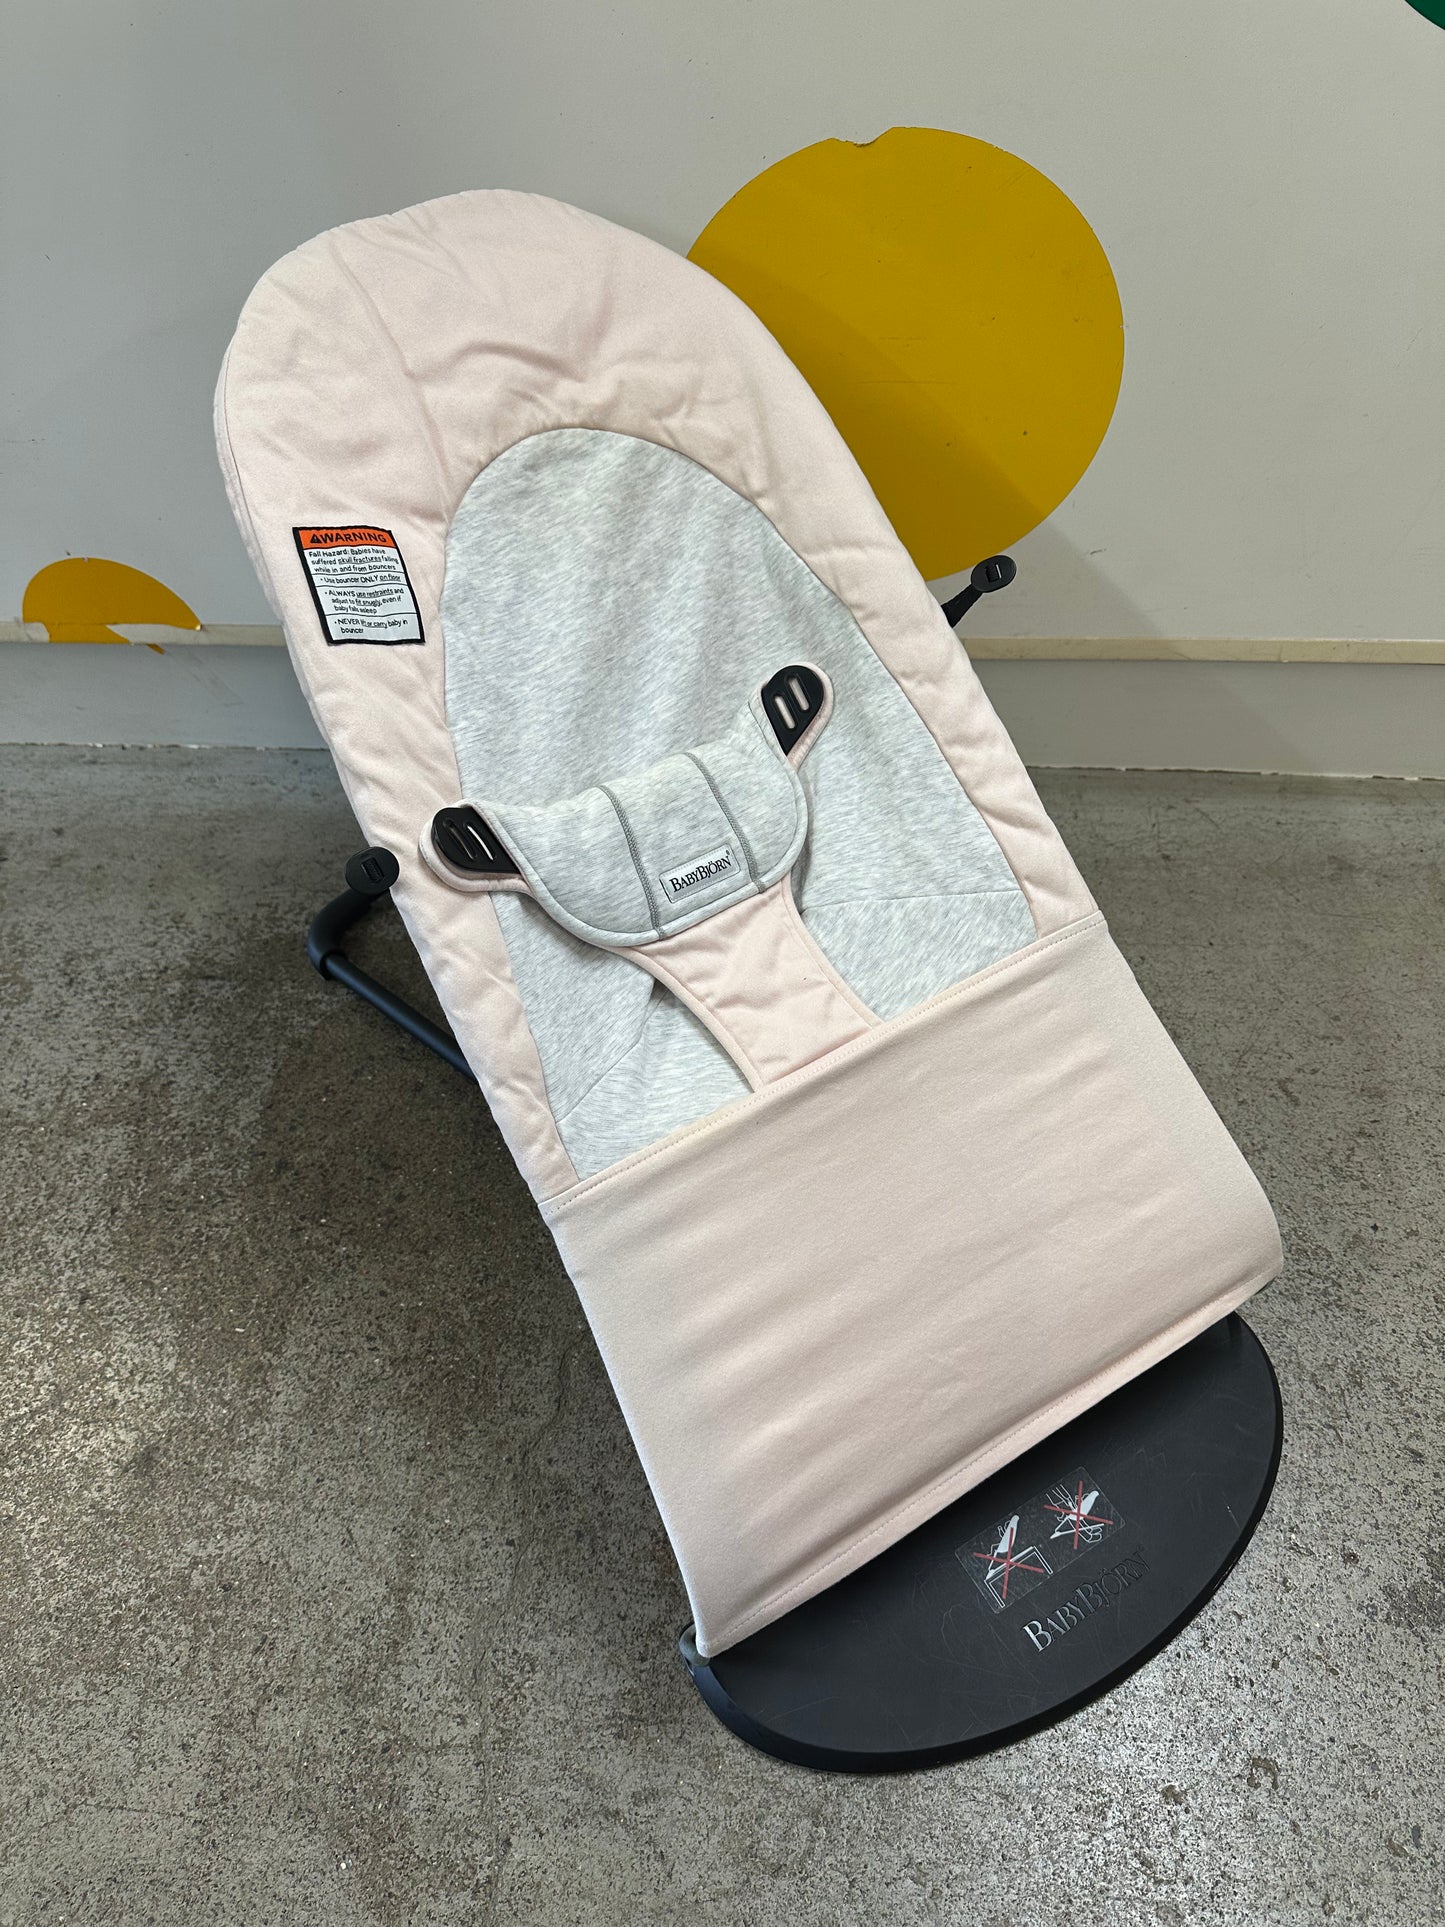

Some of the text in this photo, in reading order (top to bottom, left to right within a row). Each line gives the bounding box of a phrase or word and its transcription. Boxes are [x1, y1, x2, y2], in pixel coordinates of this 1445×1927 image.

[320, 532, 387, 544] WARNING
[382, 556, 399, 564] falling
[360, 575, 378, 583] ONLY
[366, 588, 394, 597] restraints
[388, 619, 401, 627] baby
